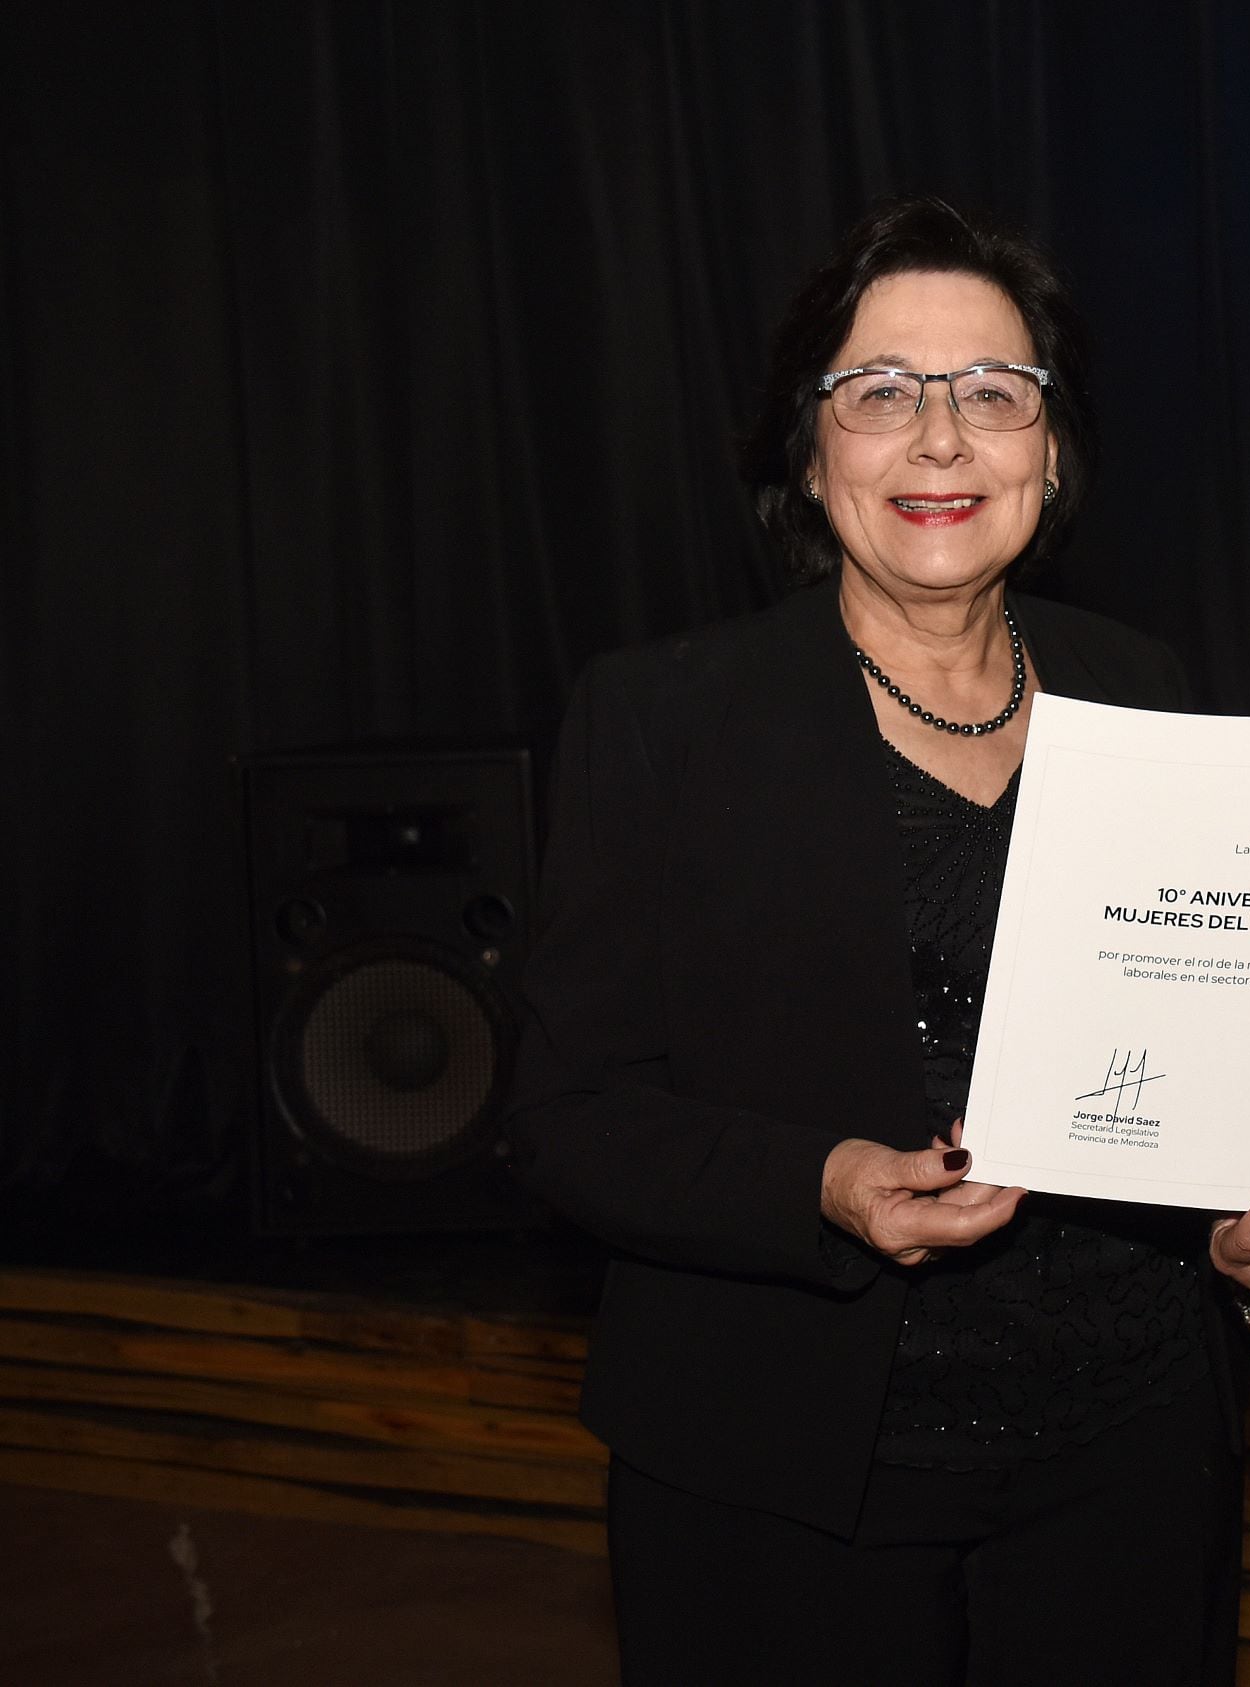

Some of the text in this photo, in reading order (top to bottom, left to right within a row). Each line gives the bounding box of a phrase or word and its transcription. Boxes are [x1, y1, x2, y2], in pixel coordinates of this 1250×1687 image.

[1235, 844, 1250, 855] La
[1104, 905, 1204, 928] MUJERES
[1208, 914, 1249, 931] DEL
[1098, 951, 1119, 961] por
[1122, 952, 1181, 967] promover
[1184, 957, 1195, 967] el
[1198, 958, 1214, 968] rol
[1216, 959, 1232, 970] de
[1235, 960, 1245, 970] la
[1123, 967, 1177, 982] laborales
[1180, 973, 1195, 983] en
[1198, 972, 1209, 983] el
[1211, 974, 1249, 985] sector
[1073, 1110, 1161, 1127] Jorge David Saez
[1071, 1121, 1159, 1138] Secretario Legislativo
[1068, 1132, 1159, 1149] Provincia de Mendoza
